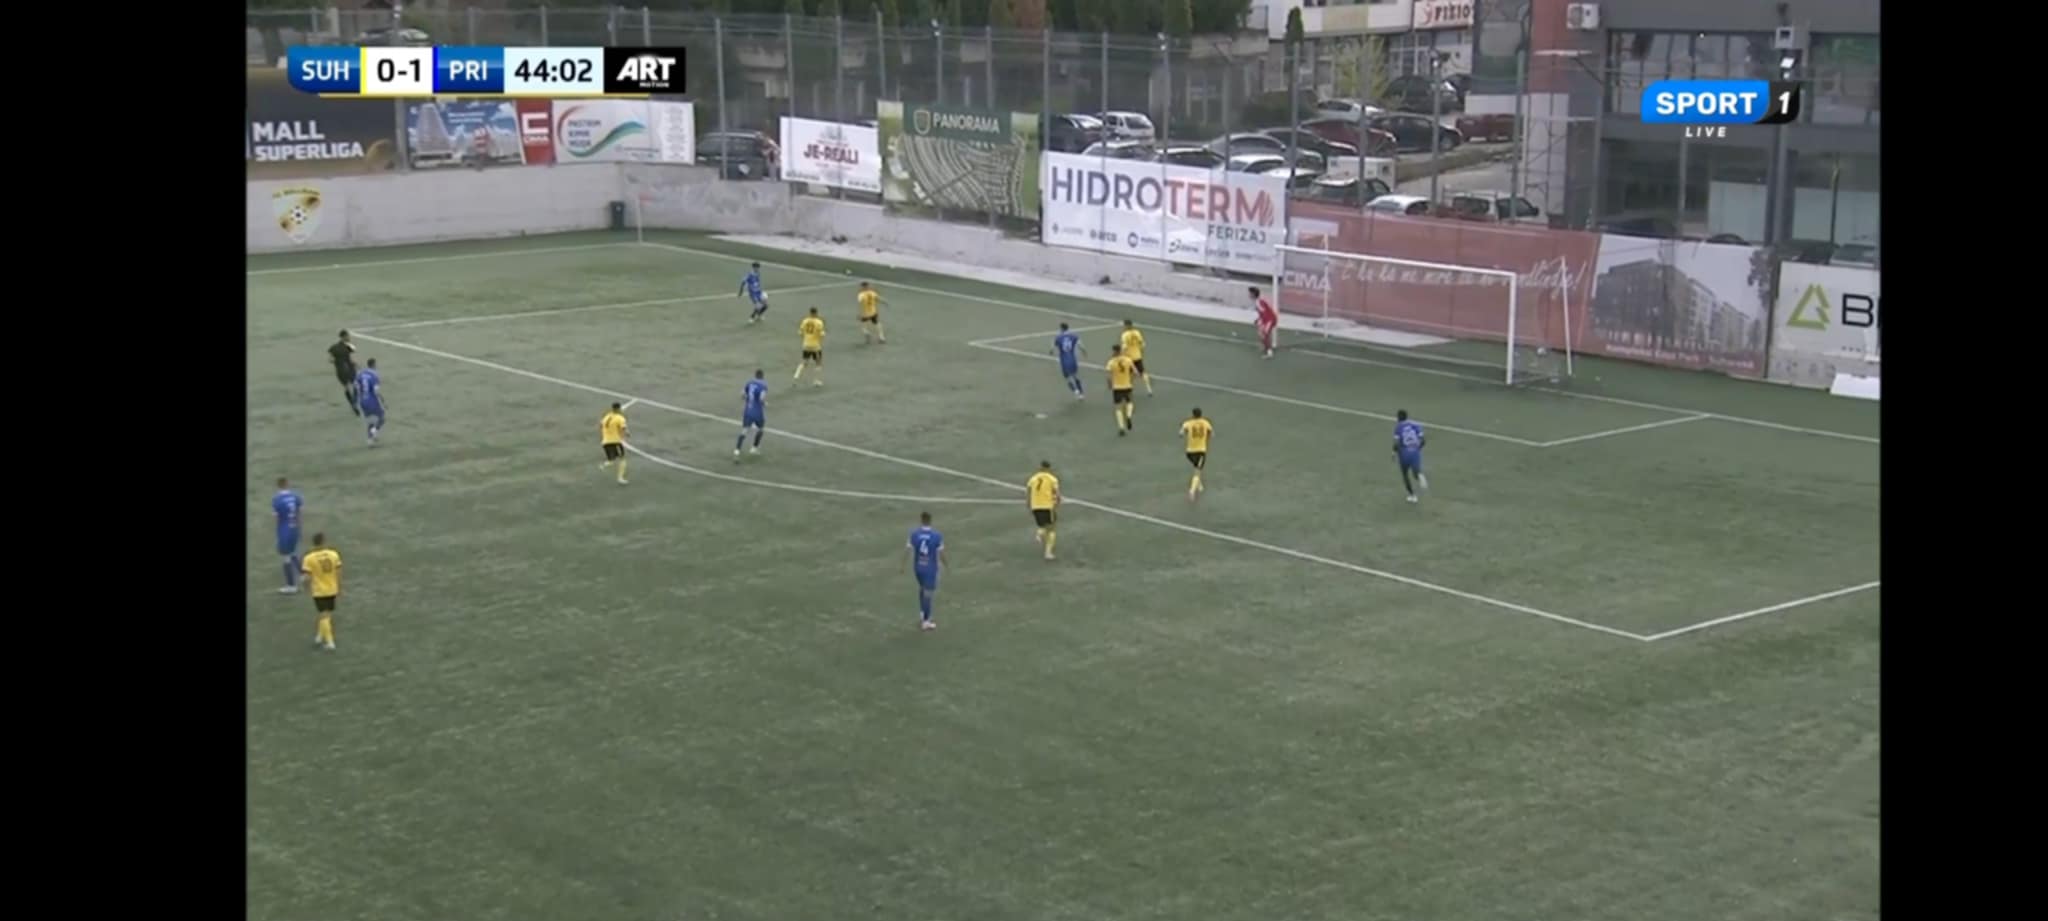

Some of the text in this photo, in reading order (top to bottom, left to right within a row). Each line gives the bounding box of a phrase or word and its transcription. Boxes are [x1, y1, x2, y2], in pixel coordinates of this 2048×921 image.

[252, 120, 326, 142] MALL
[932, 111, 1000, 134] PANORAMA
[254, 141, 365, 162] SUPERLIGA
[803, 143, 859, 165] JE-REALI
[1051, 165, 1270, 228] HIDROTERM
[1207, 223, 1266, 244] FERIZAJ
[1842, 293, 1880, 328] B
[919, 540, 929, 555] 4
